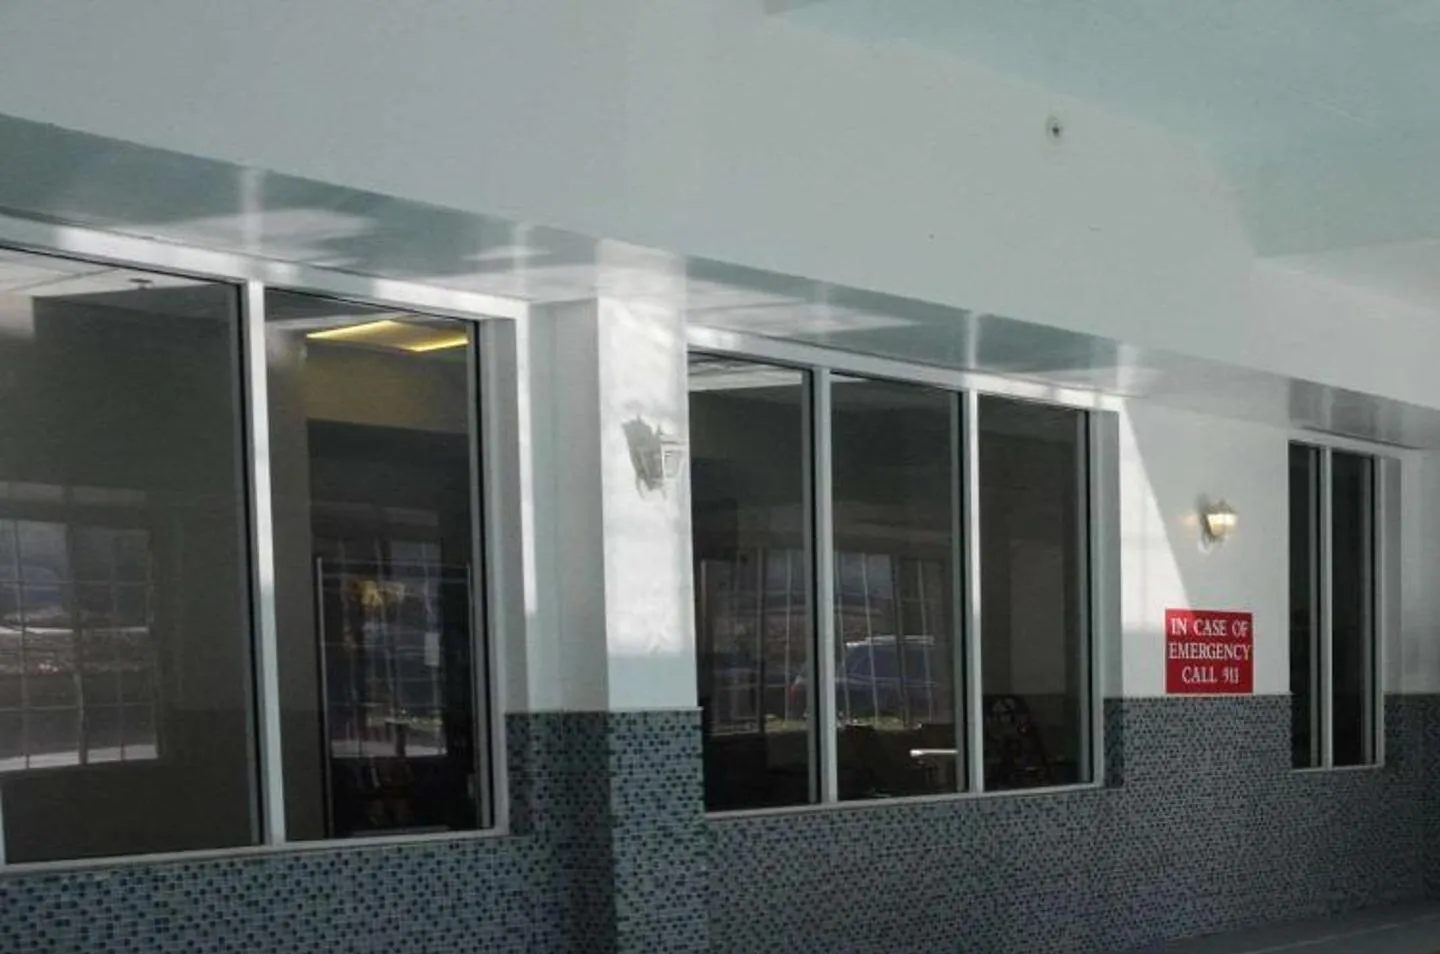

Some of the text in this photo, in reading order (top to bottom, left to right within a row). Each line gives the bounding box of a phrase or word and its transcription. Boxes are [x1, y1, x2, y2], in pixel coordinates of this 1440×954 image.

[1171, 618, 1248, 637] IN CASE OF
[1168, 641, 1251, 660] EMERGENCY
[1181, 665, 1217, 684] CALL
